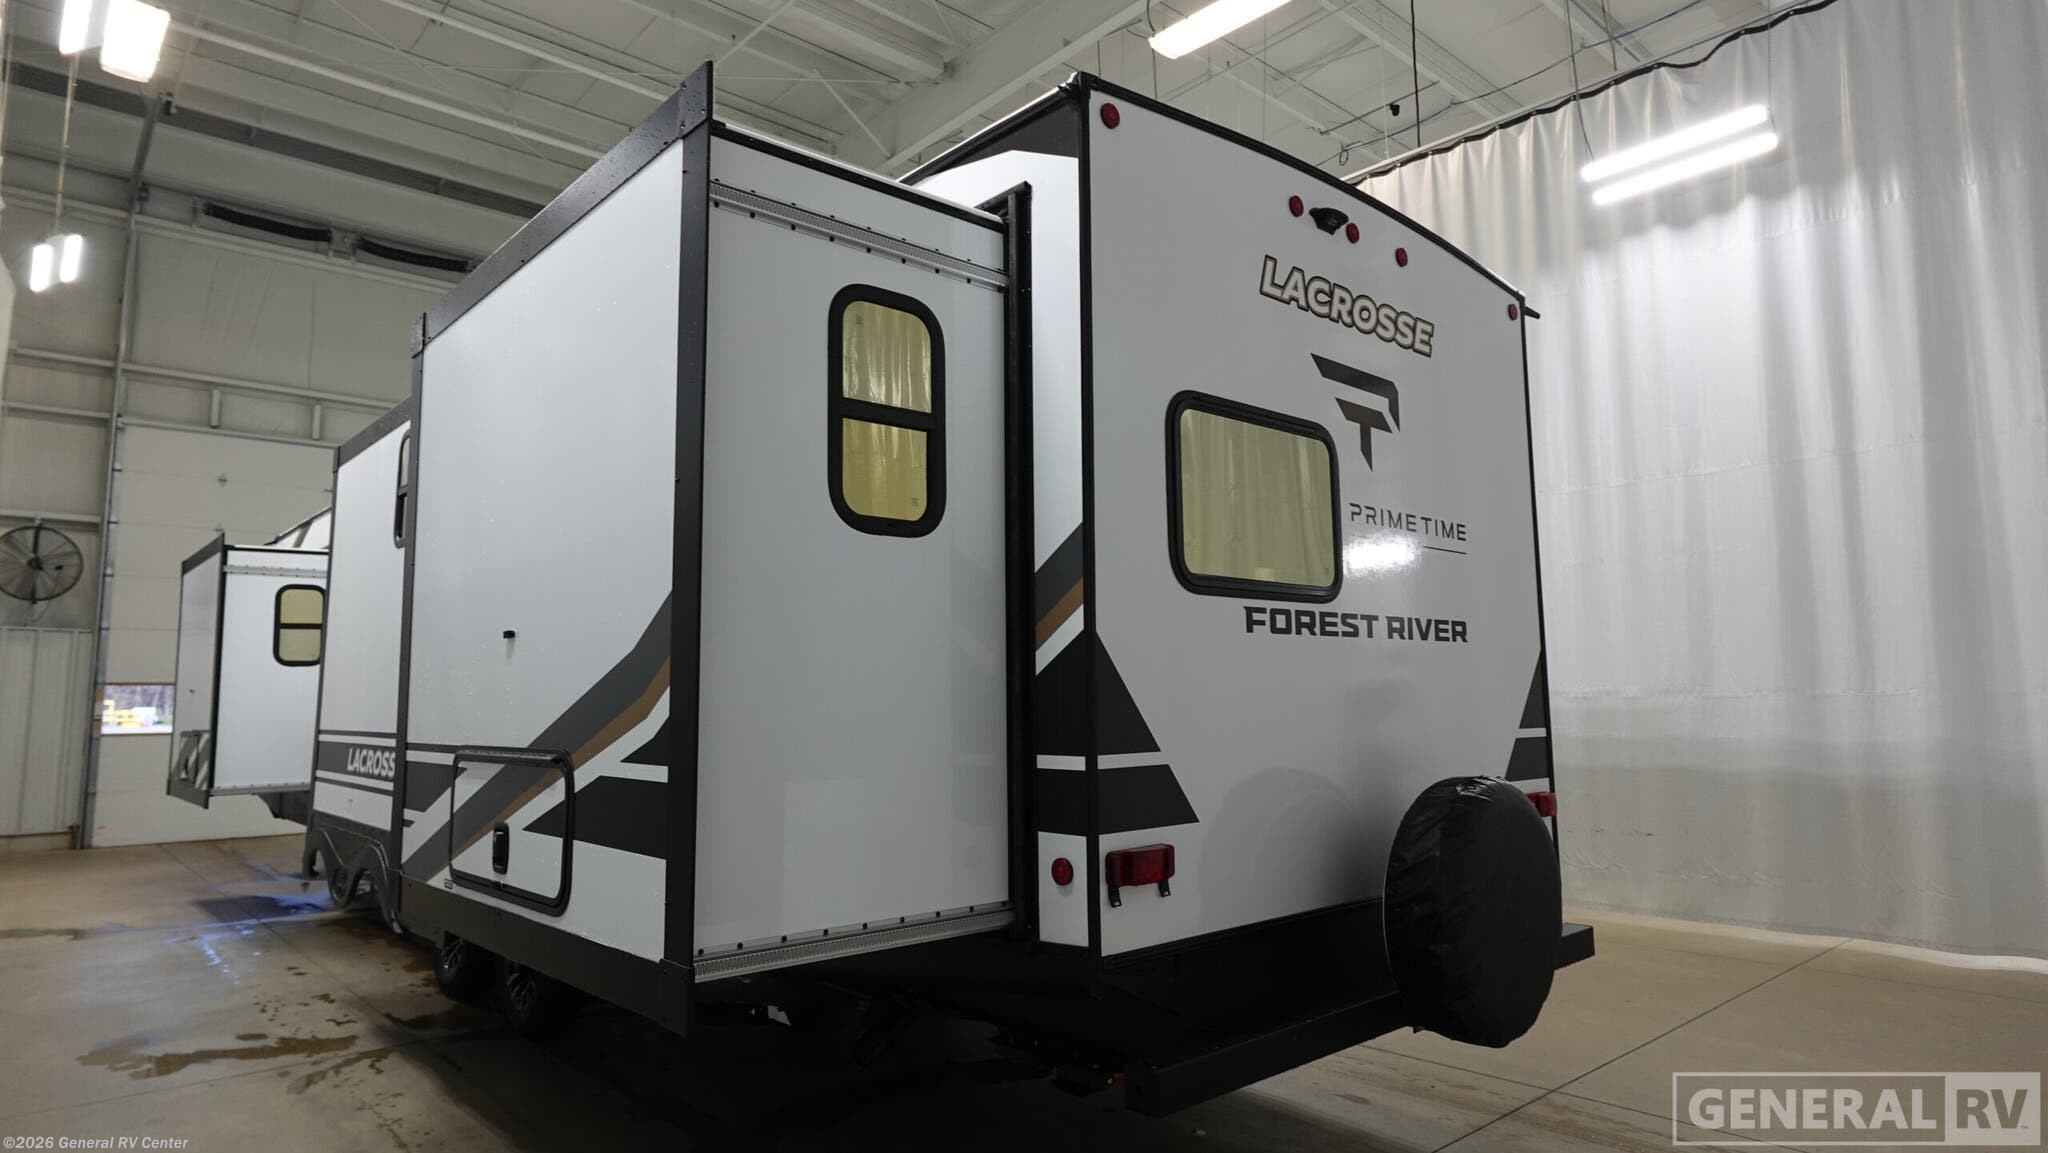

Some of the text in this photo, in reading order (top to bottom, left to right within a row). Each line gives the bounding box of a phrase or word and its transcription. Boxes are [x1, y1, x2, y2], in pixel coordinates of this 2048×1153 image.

[1259, 254, 1434, 358] LACROSSE
[1243, 606, 1468, 643] FOREST RIVER
